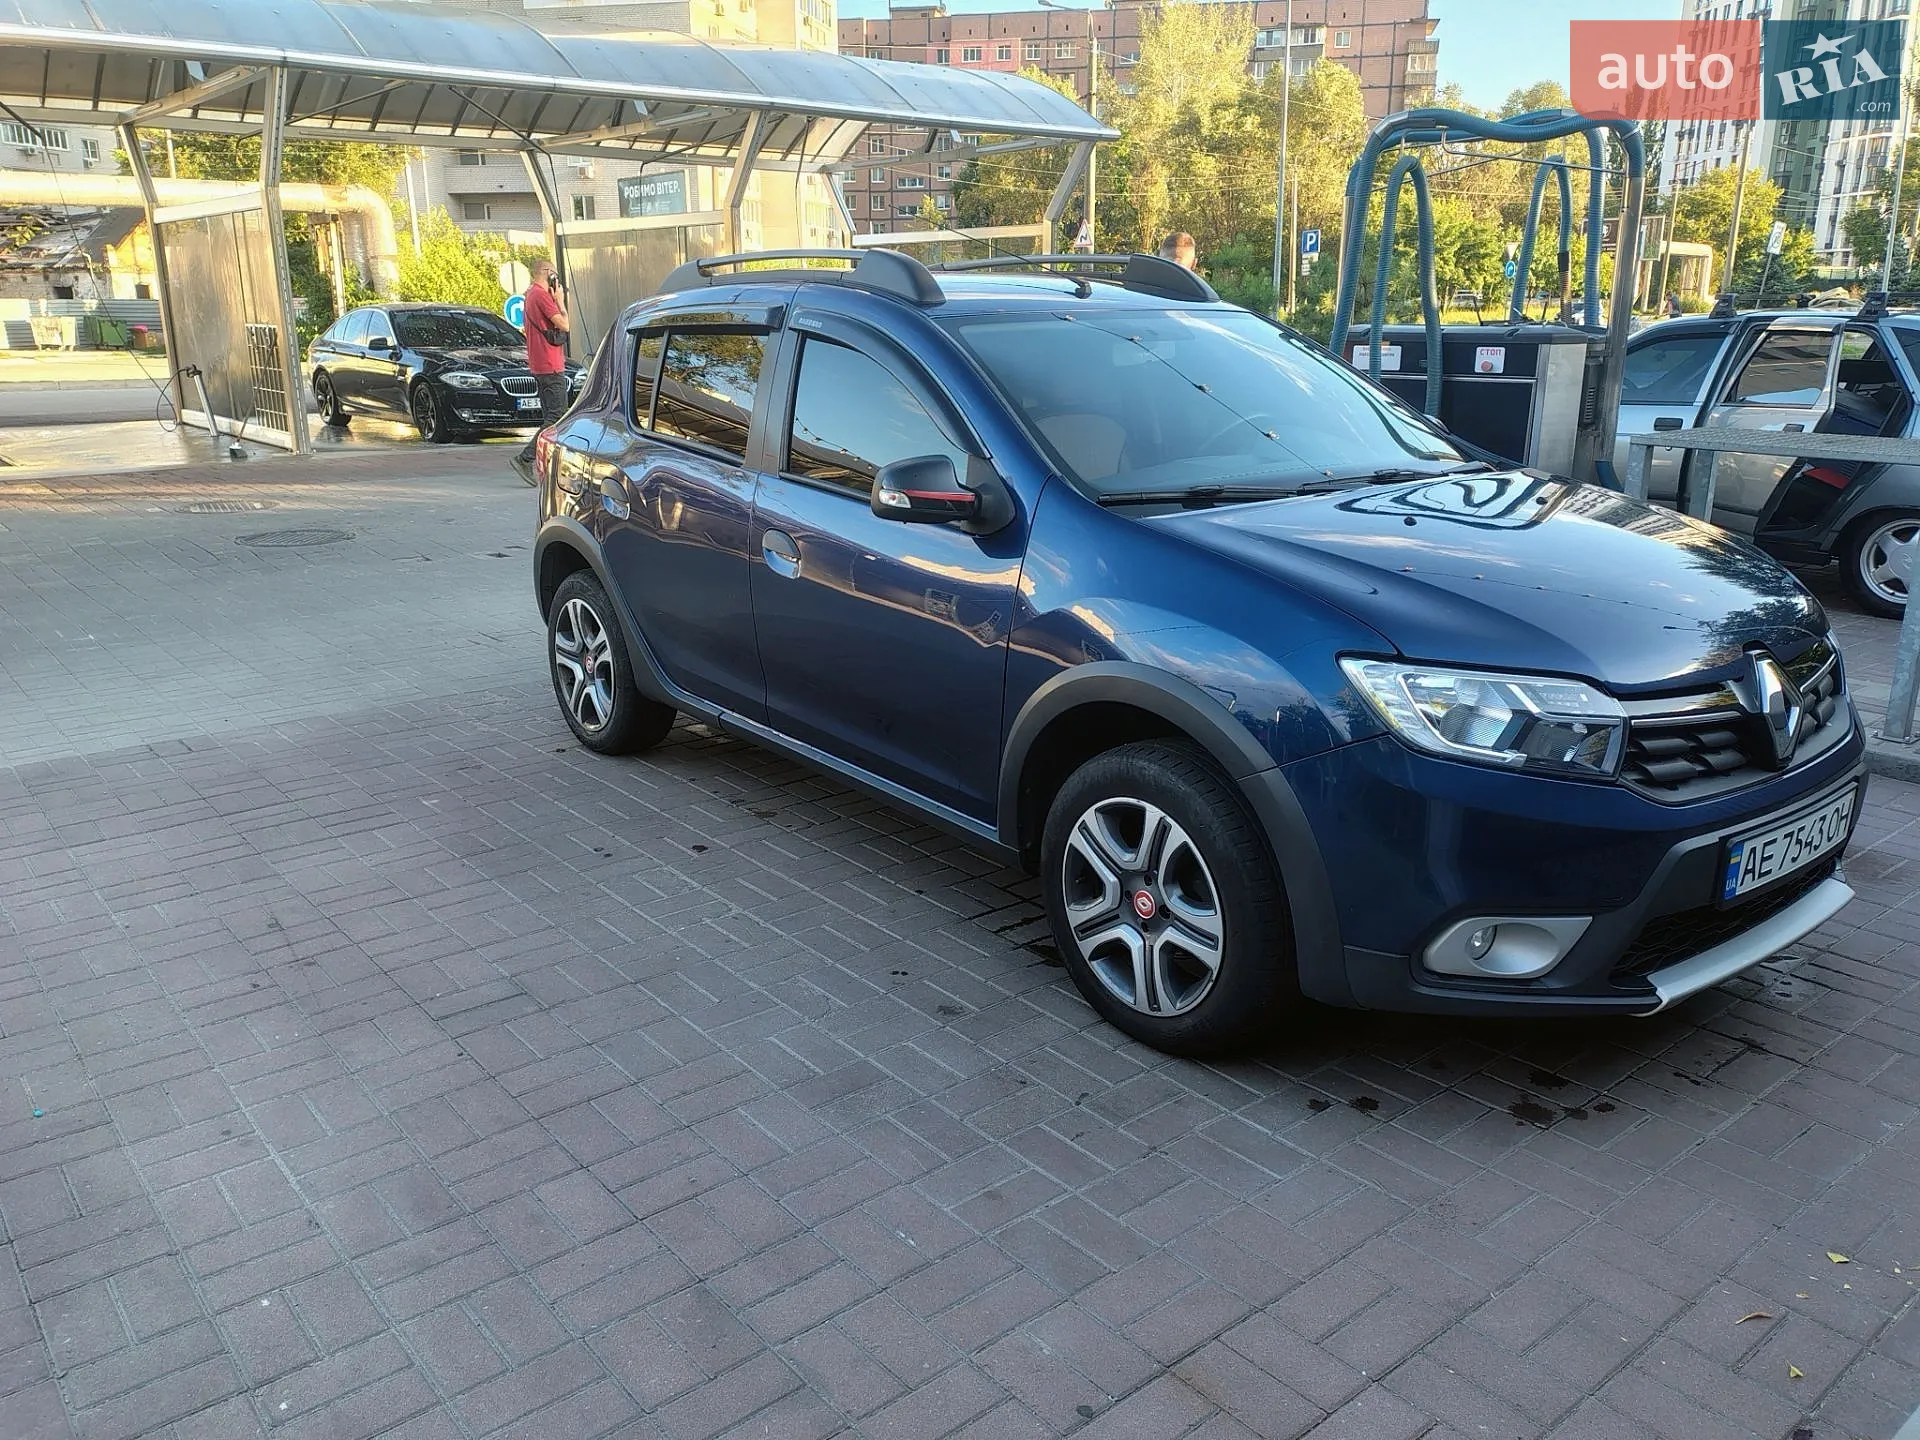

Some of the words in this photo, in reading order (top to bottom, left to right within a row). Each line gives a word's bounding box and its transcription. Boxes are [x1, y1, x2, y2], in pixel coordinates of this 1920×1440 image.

[656, 180, 681, 196] ВІТЕР.
[1307, 232, 1317, 252] P
[1479, 348, 1502, 356] СТОП
[522, 399, 532, 407] AE
[1739, 837, 1778, 887] AE
[1778, 814, 1828, 871] 7543
[1827, 797, 1853, 843] OH
[1725, 877, 1737, 890] UA
